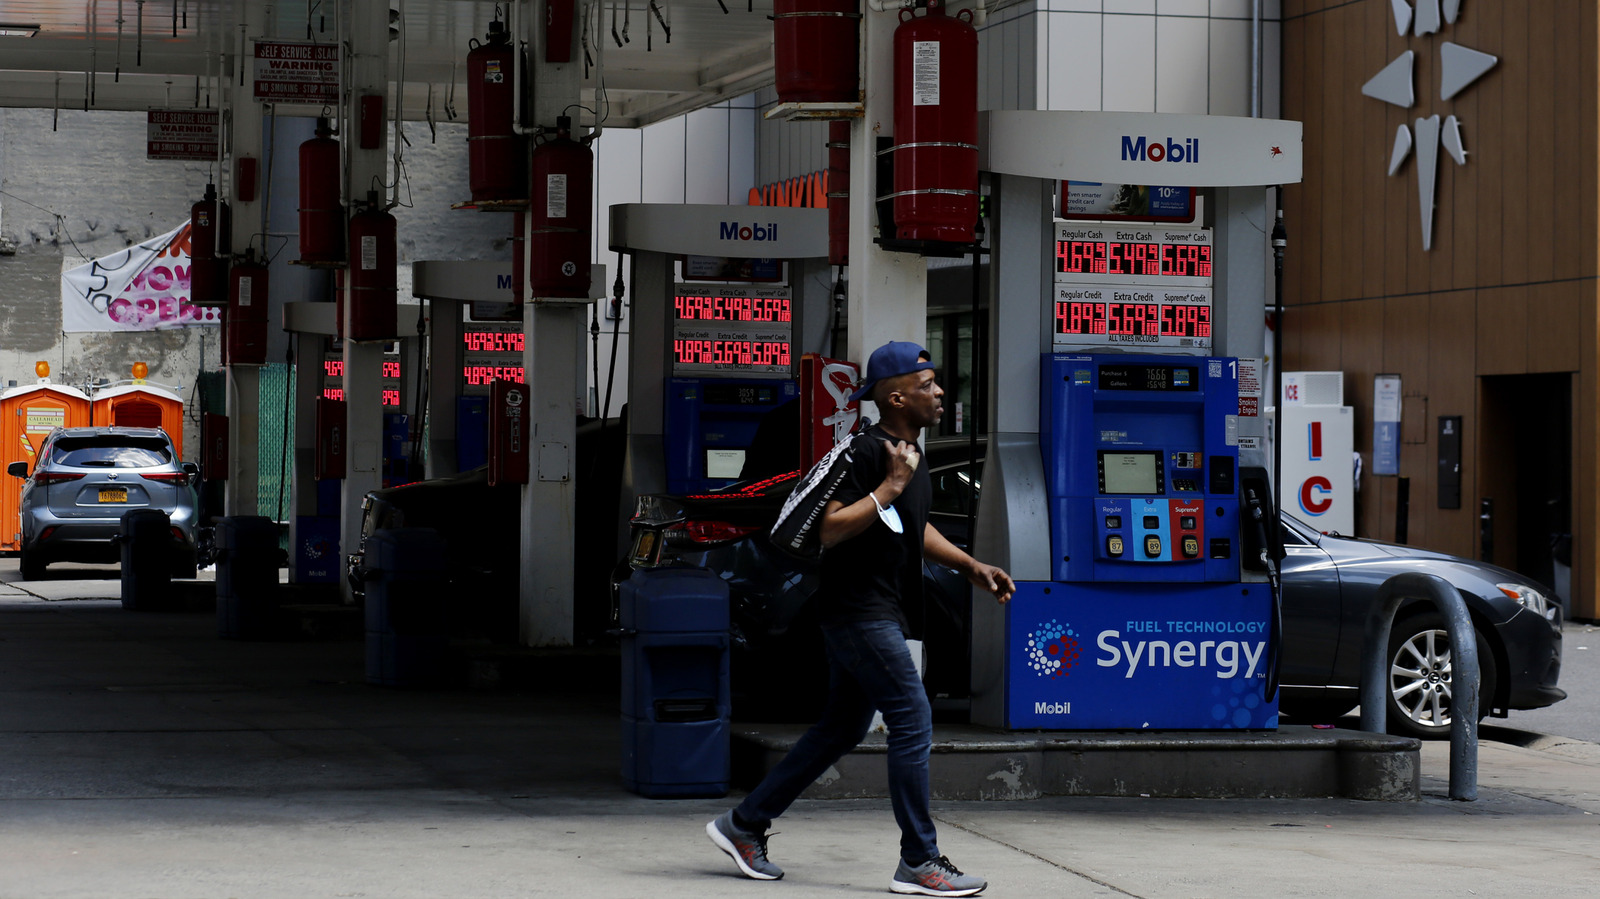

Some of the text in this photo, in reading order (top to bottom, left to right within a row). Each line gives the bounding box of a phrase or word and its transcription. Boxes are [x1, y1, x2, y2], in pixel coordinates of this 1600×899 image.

[260, 45, 338, 60] SELF SERVICE ISLAN
[269, 60, 333, 70] WARNING
[260, 82, 268, 92] NO
[271, 83, 298, 93] SMOKING
[302, 84, 318, 94] STOP
[153, 112, 168, 122] SELF
[170, 113, 195, 123] SERVICE
[160, 125, 212, 133] WARNING
[1121, 136, 1199, 164] Mobil
[720, 222, 777, 241] Mobil
[1062, 230, 1103, 240] Regular Cash
[1116, 232, 1152, 241] Extra Cash
[1060, 290, 1102, 300] Regular Credit
[1114, 292, 1154, 301] Extra Credit
[1228, 360, 1236, 379] 1
[1285, 384, 1298, 401] ICE
[1239, 398, 1257, 407] Smoking
[1243, 406, 1256, 415] Engine
[402, 414, 408, 424] 7
[1127, 621, 1266, 633] FUEL TECHNOLOGY
[1096, 629, 1266, 679] Synergy
[1035, 701, 1071, 714] Mobil
